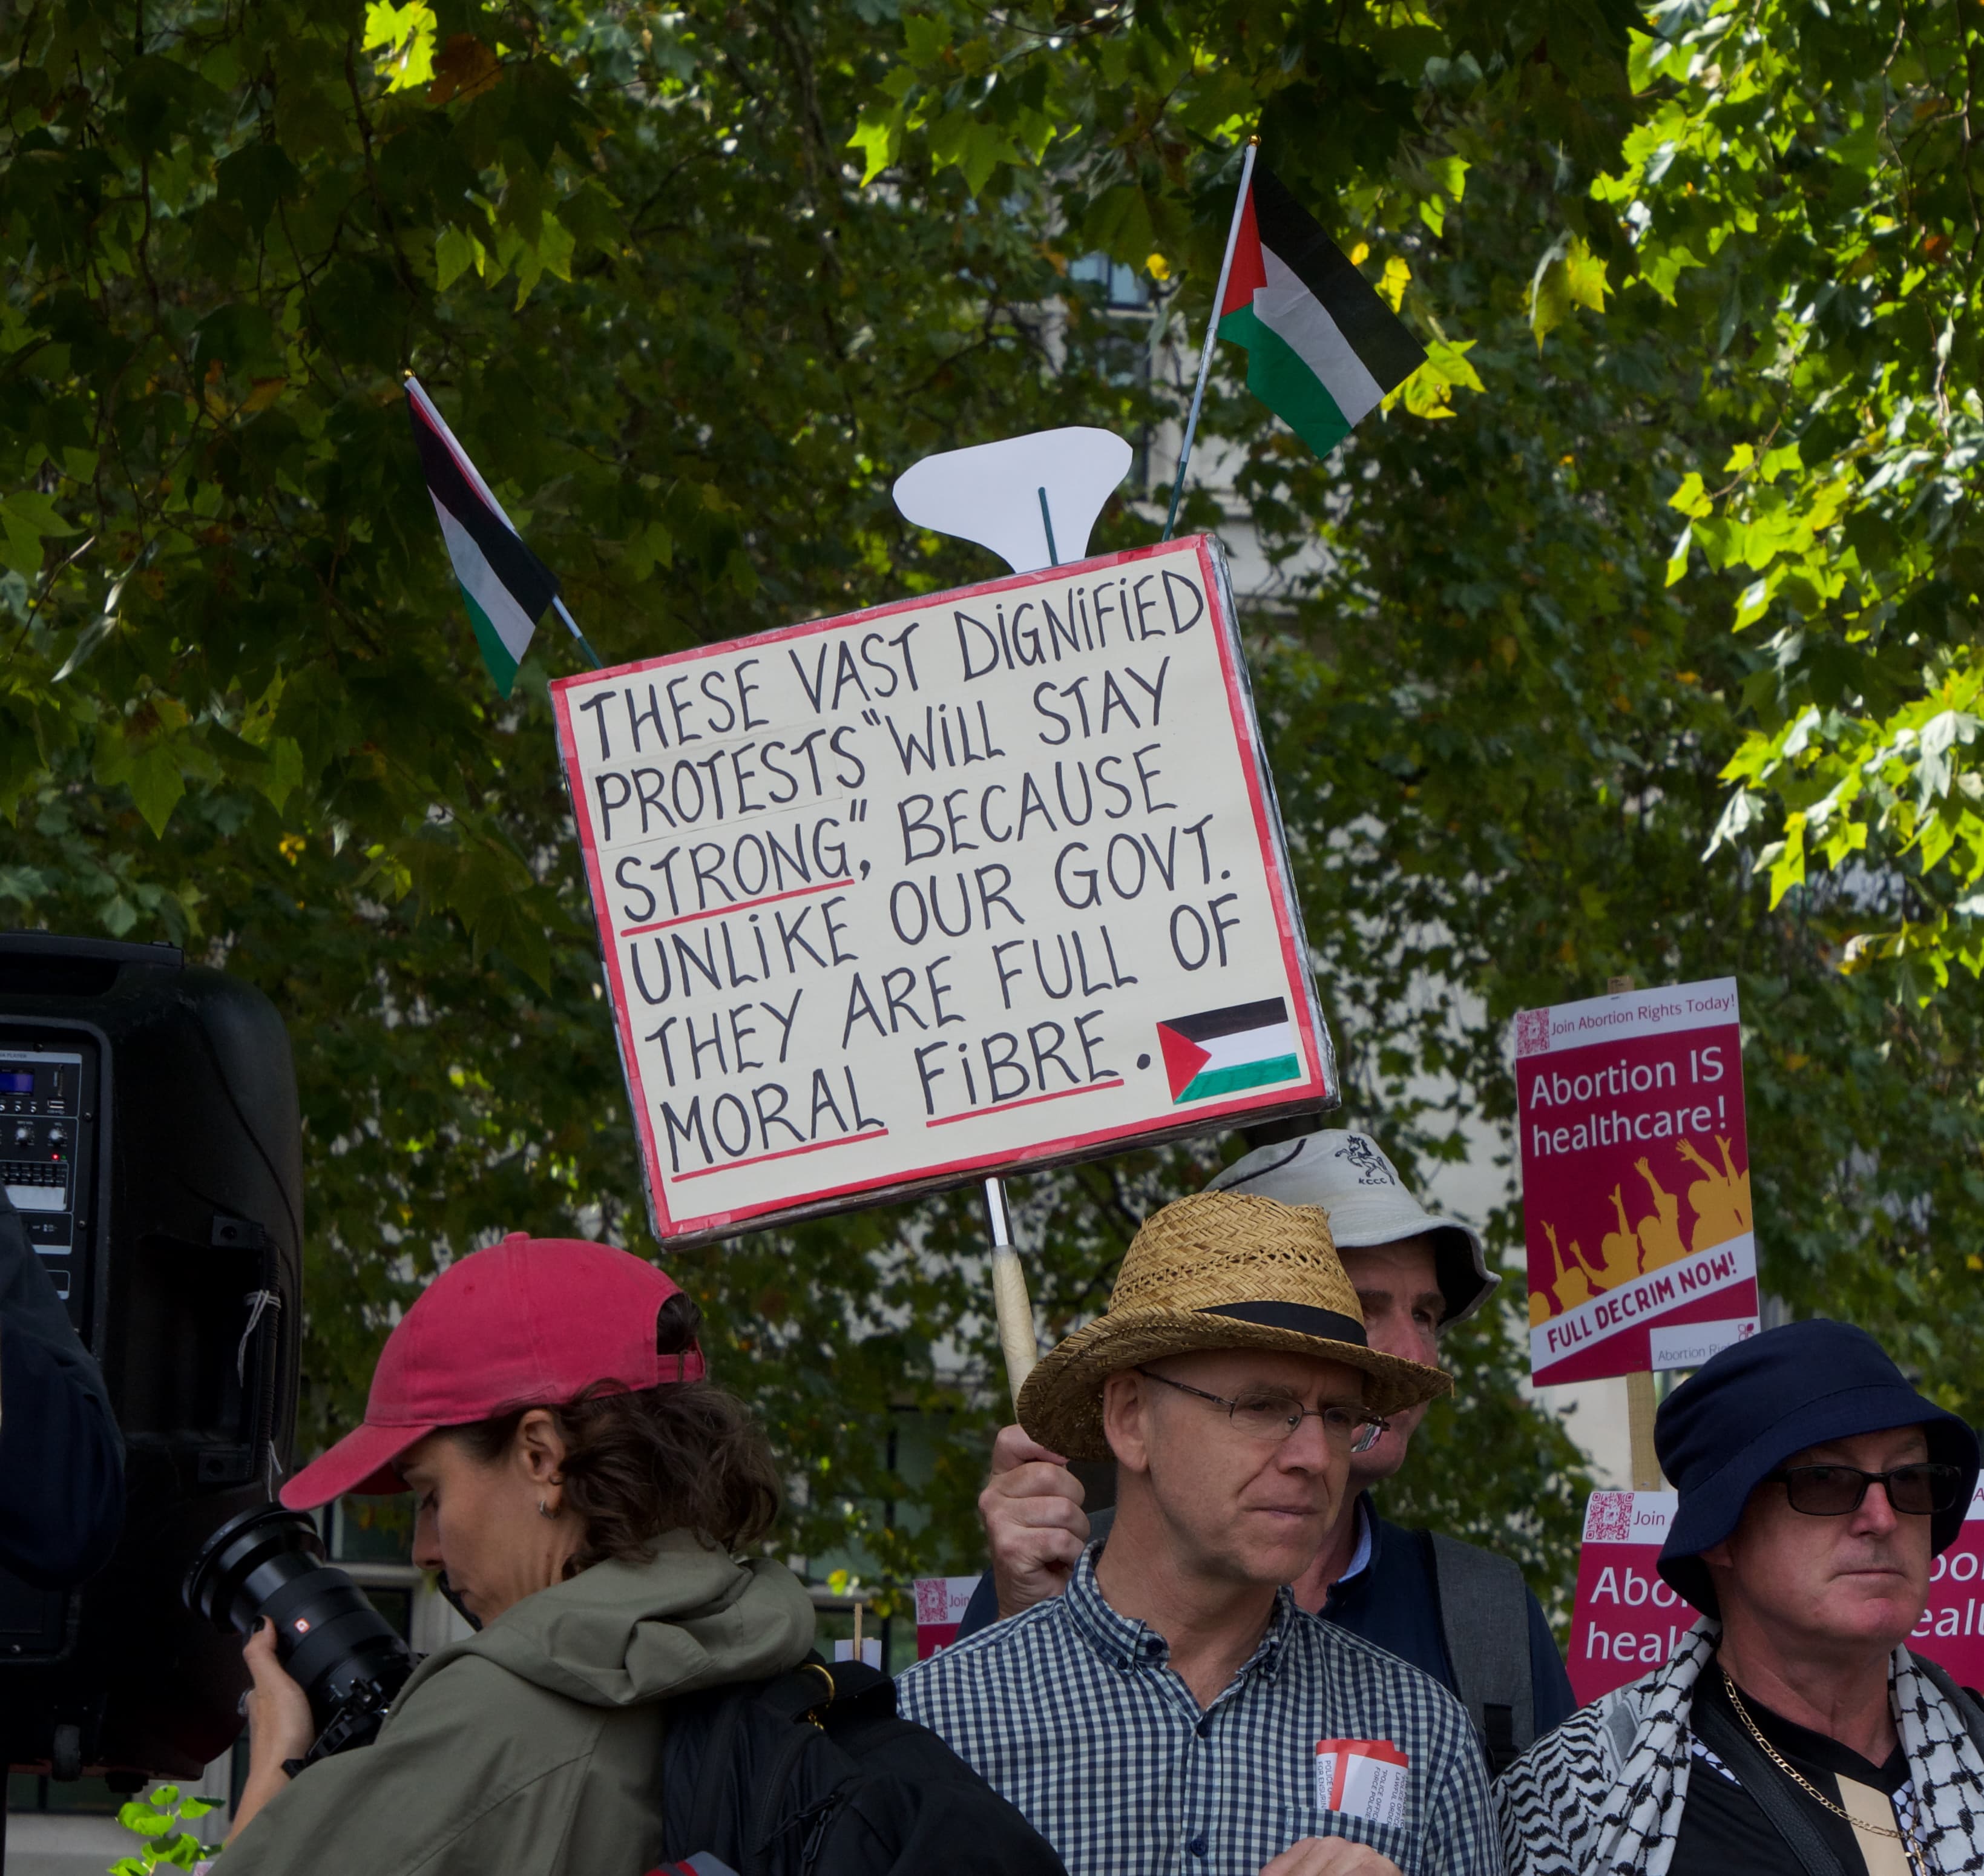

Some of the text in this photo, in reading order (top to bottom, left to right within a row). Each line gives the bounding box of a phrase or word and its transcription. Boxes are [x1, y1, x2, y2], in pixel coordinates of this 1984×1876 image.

[580, 659, 769, 761] THESE
[789, 623, 921, 714] VAST
[594, 726, 866, 841] PROTESTS
[1033, 656, 1171, 745] STAY
[898, 743, 1177, 866] BECAUSE
[890, 863, 1025, 946] OUR
[1055, 814, 1231, 909] GOVT.
[645, 892, 1240, 1087] THEY ARE FULL OF
[1551, 993, 1735, 1035] Join Abortion Rights Today!
[1530, 1046, 1724, 1110] Abortion IS
[660, 1066, 885, 1173] MORAL
[1533, 1096, 1726, 1157] healthcare!
[1547, 1251, 1737, 1354] FULL DECRIM NOW!
[1658, 1346, 1706, 1361] Abortion
[1633, 1510, 1665, 1525] Join
[1589, 1567, 1687, 1608] Abo
[1586, 1621, 1678, 1663] heal
[1318, 1777, 1327, 1809] ENSURIN
[1325, 1760, 1333, 1786] POLICE
[1365, 1766, 1381, 1819] FORCE POLICIE
[1391, 1772, 1401, 1800] LAWFUL
[1393, 1803, 1402, 1827] OFFICE
